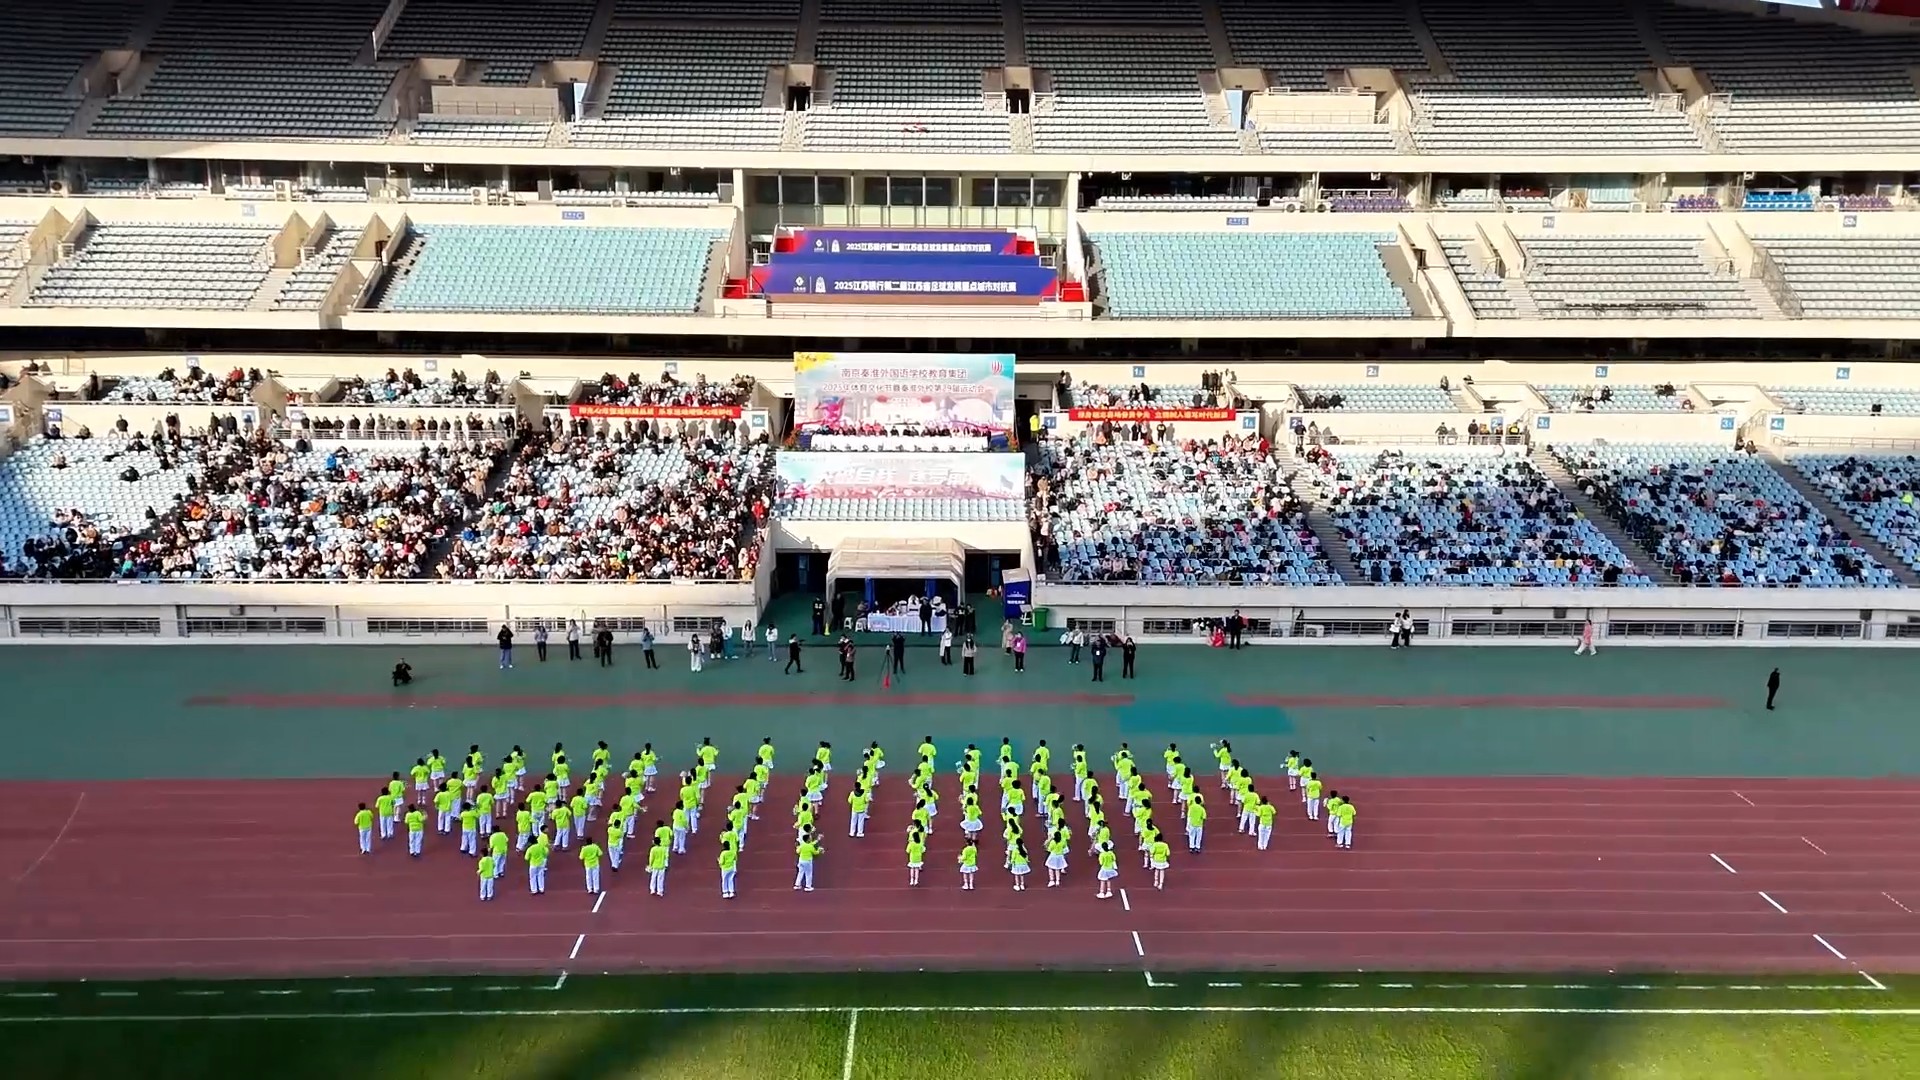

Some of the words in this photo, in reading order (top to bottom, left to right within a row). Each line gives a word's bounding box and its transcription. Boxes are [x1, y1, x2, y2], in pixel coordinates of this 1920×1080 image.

[841, 368, 967, 378] 南京秦淮外国语学校教育集团
